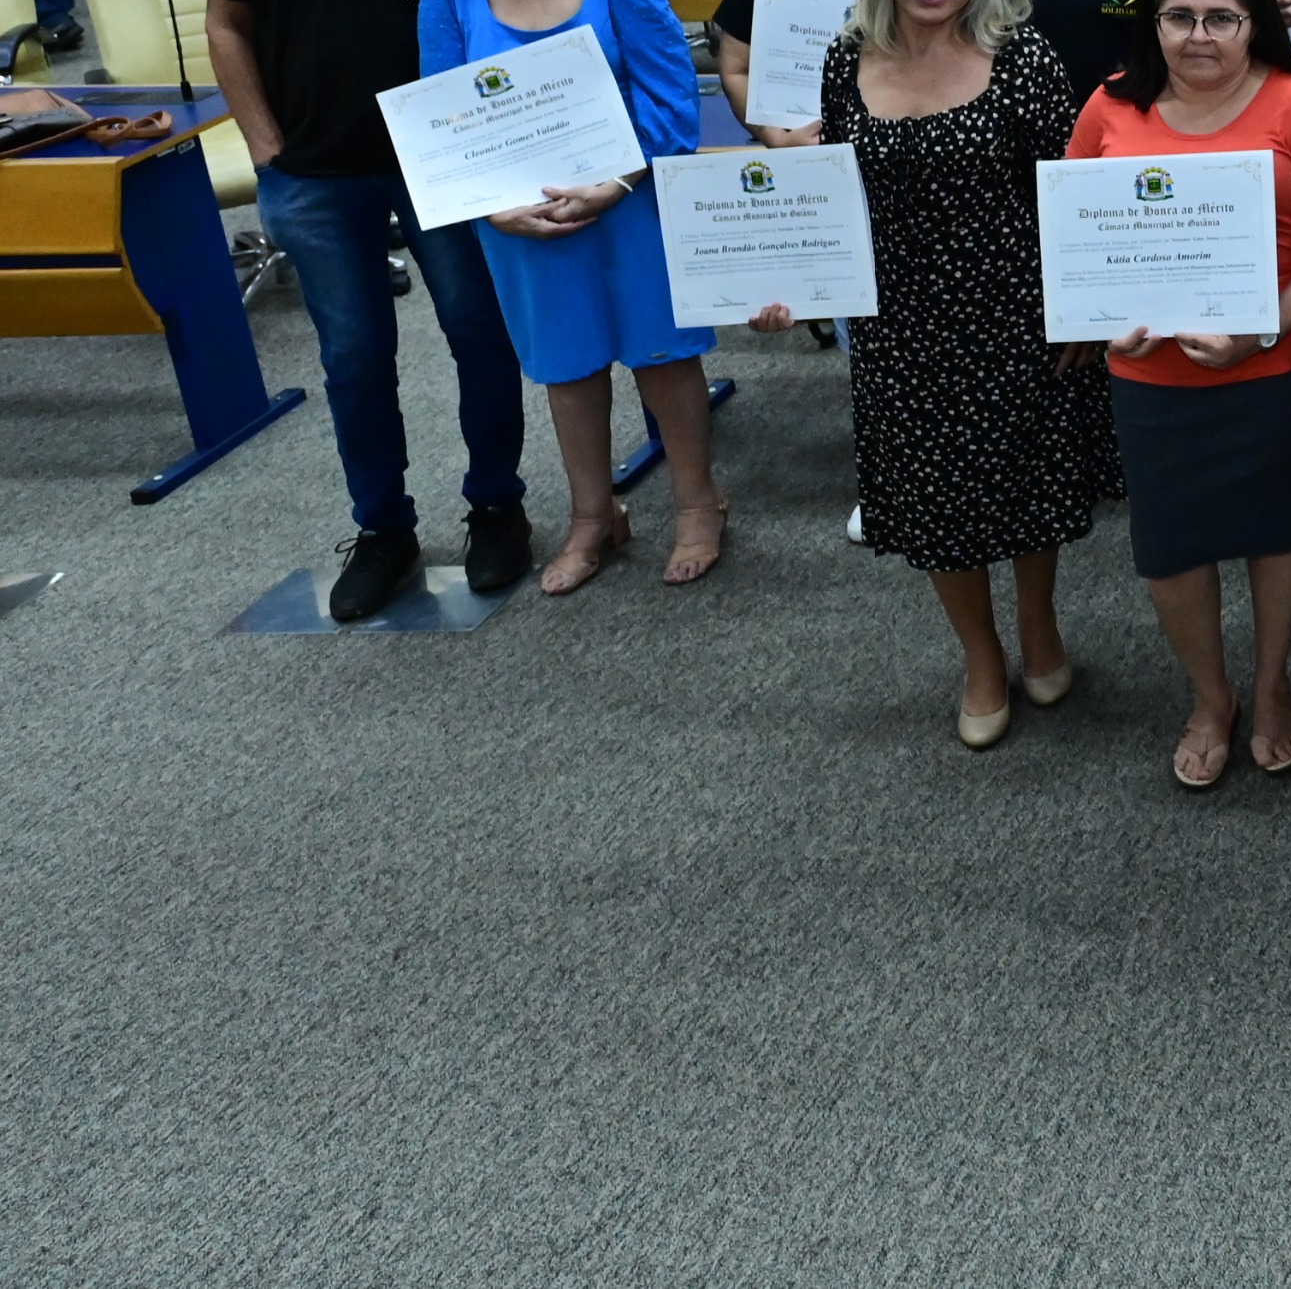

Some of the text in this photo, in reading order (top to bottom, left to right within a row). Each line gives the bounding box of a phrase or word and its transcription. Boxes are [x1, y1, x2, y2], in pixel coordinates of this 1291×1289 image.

[790, 24, 831, 37] Diploma
[795, 62, 814, 71] Télia
[429, 77, 574, 129] Diploma de Honra ao Mérito
[464, 120, 570, 160] Cleonice Gomes Valadão
[694, 201, 734, 211] Diploma
[738, 199, 747, 208] de
[750, 197, 780, 208] Honra
[797, 194, 828, 205] Mérito
[1079, 202, 1235, 219] Diploma de Honra ao Mérito
[694, 238, 840, 256] Joana Brandão Gonçalves Rodrigues
[1106, 251, 1211, 264] Kátia Cardoso Amorim
